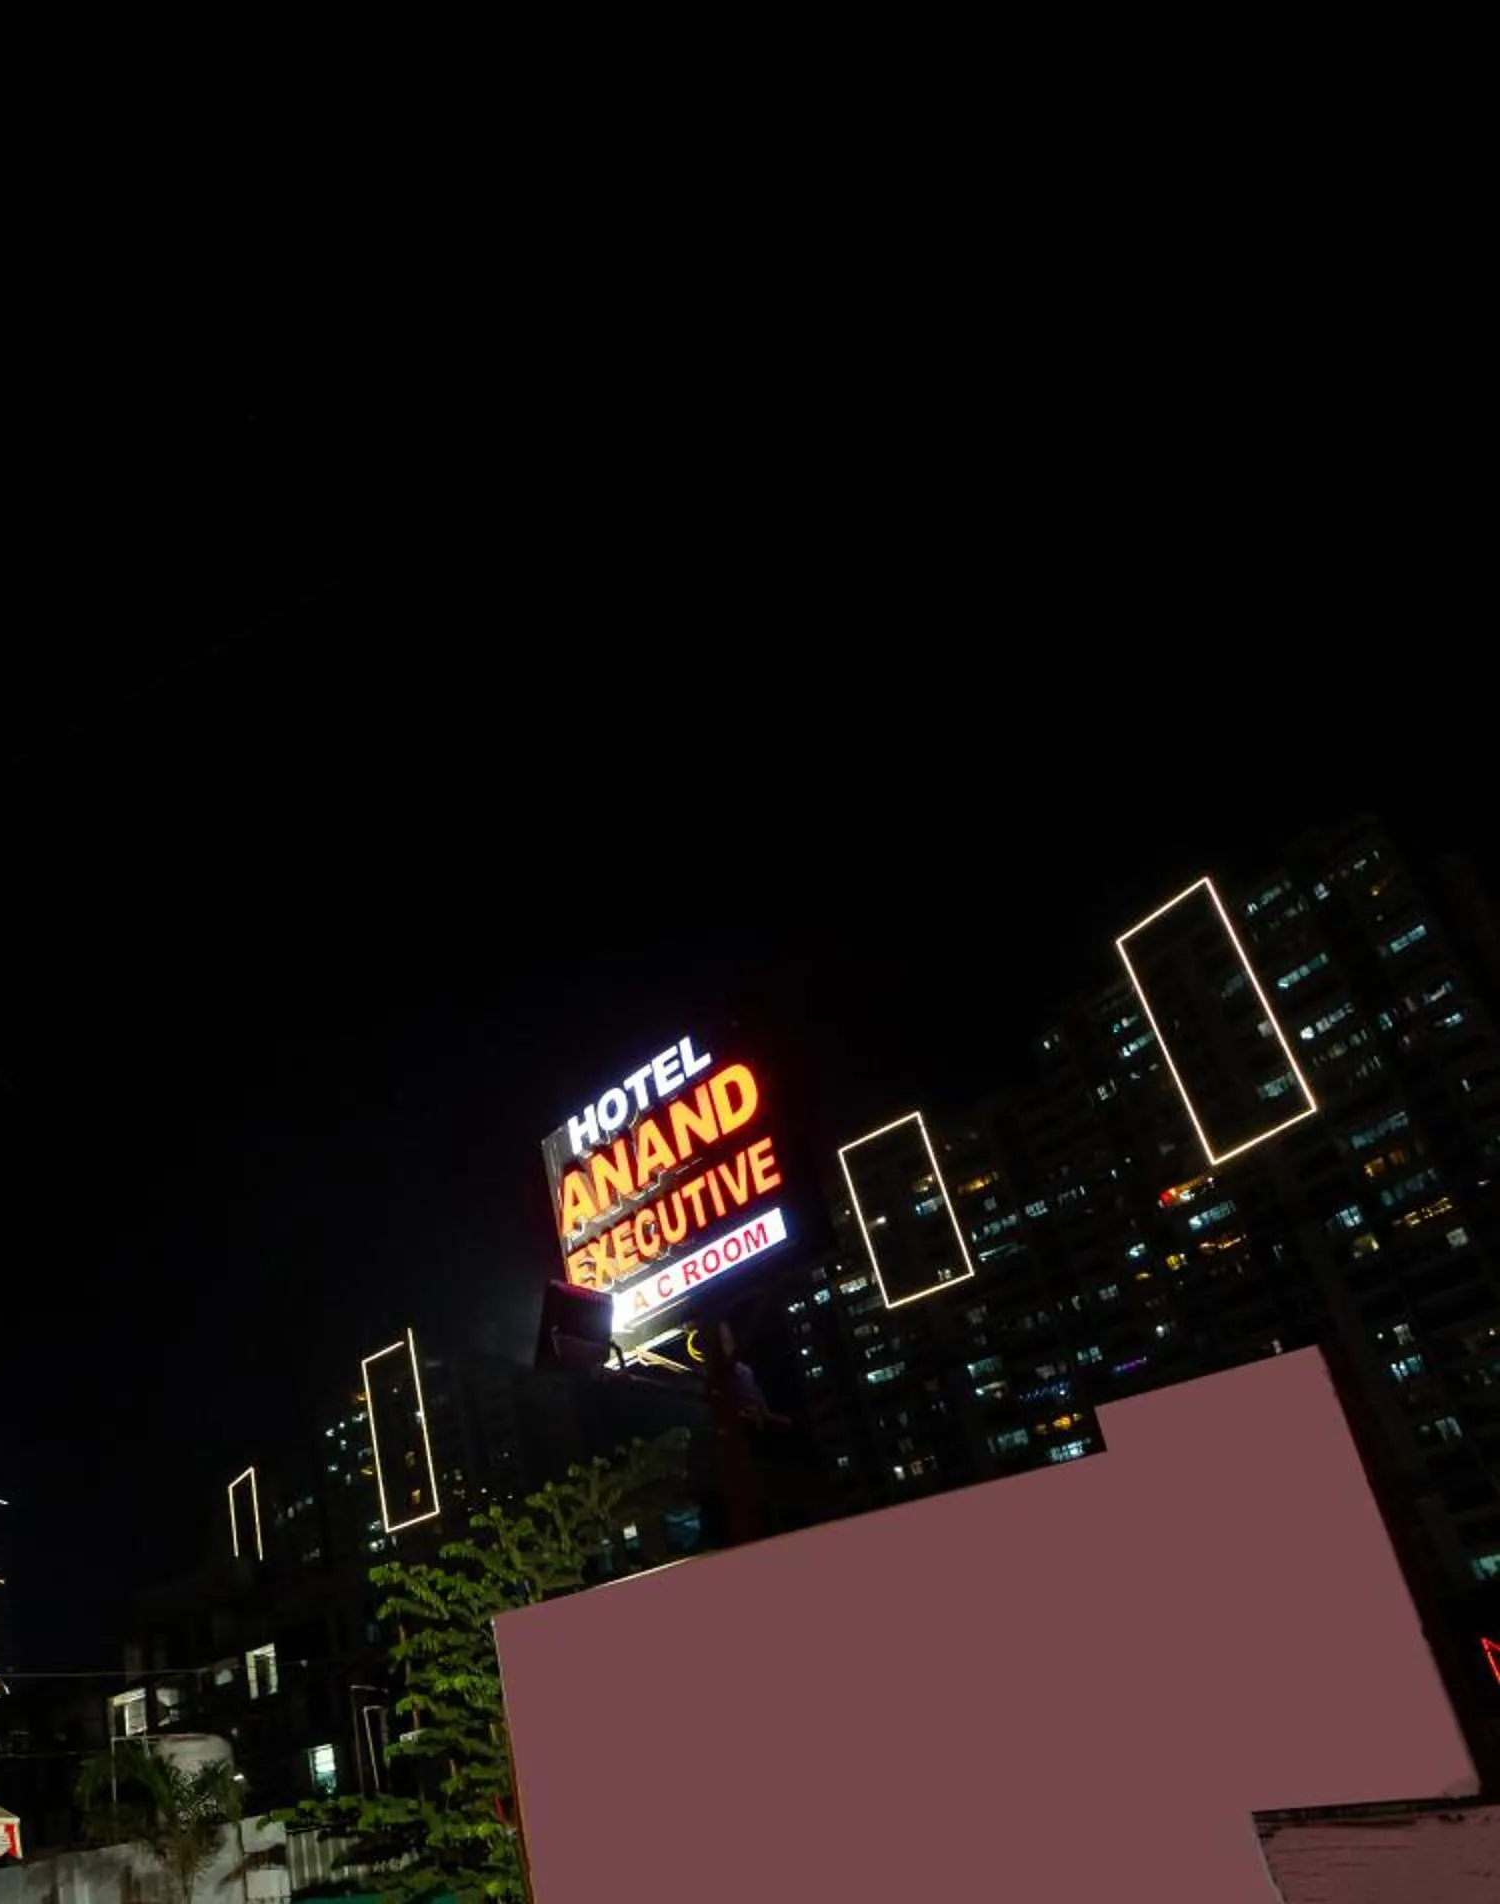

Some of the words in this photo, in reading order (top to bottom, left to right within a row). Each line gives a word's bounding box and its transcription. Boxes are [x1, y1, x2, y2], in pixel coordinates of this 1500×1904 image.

[561, 1063, 759, 1235] ANAND
[568, 1036, 711, 1154] HOTEL
[566, 1138, 781, 1289] EXECUTIVE
[681, 1222, 769, 1286] ROOM
